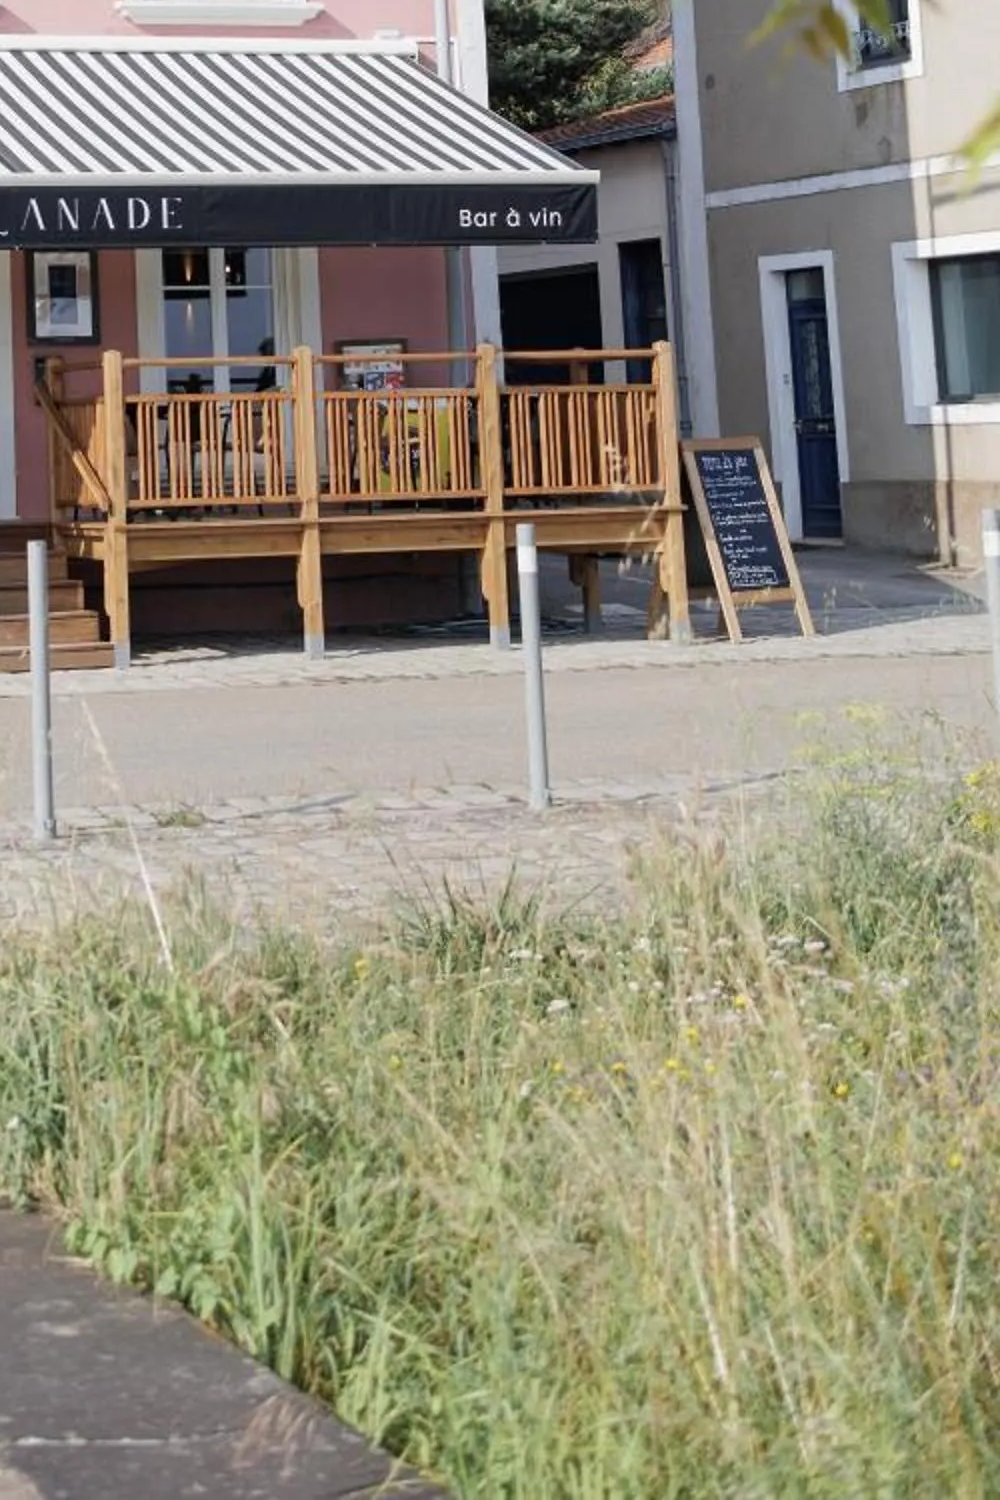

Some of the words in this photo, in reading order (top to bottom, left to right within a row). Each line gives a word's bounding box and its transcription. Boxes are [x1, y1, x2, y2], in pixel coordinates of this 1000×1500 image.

[459, 209, 498, 227] Bar
[506, 207, 521, 227] à
[529, 208, 562, 227] vin
